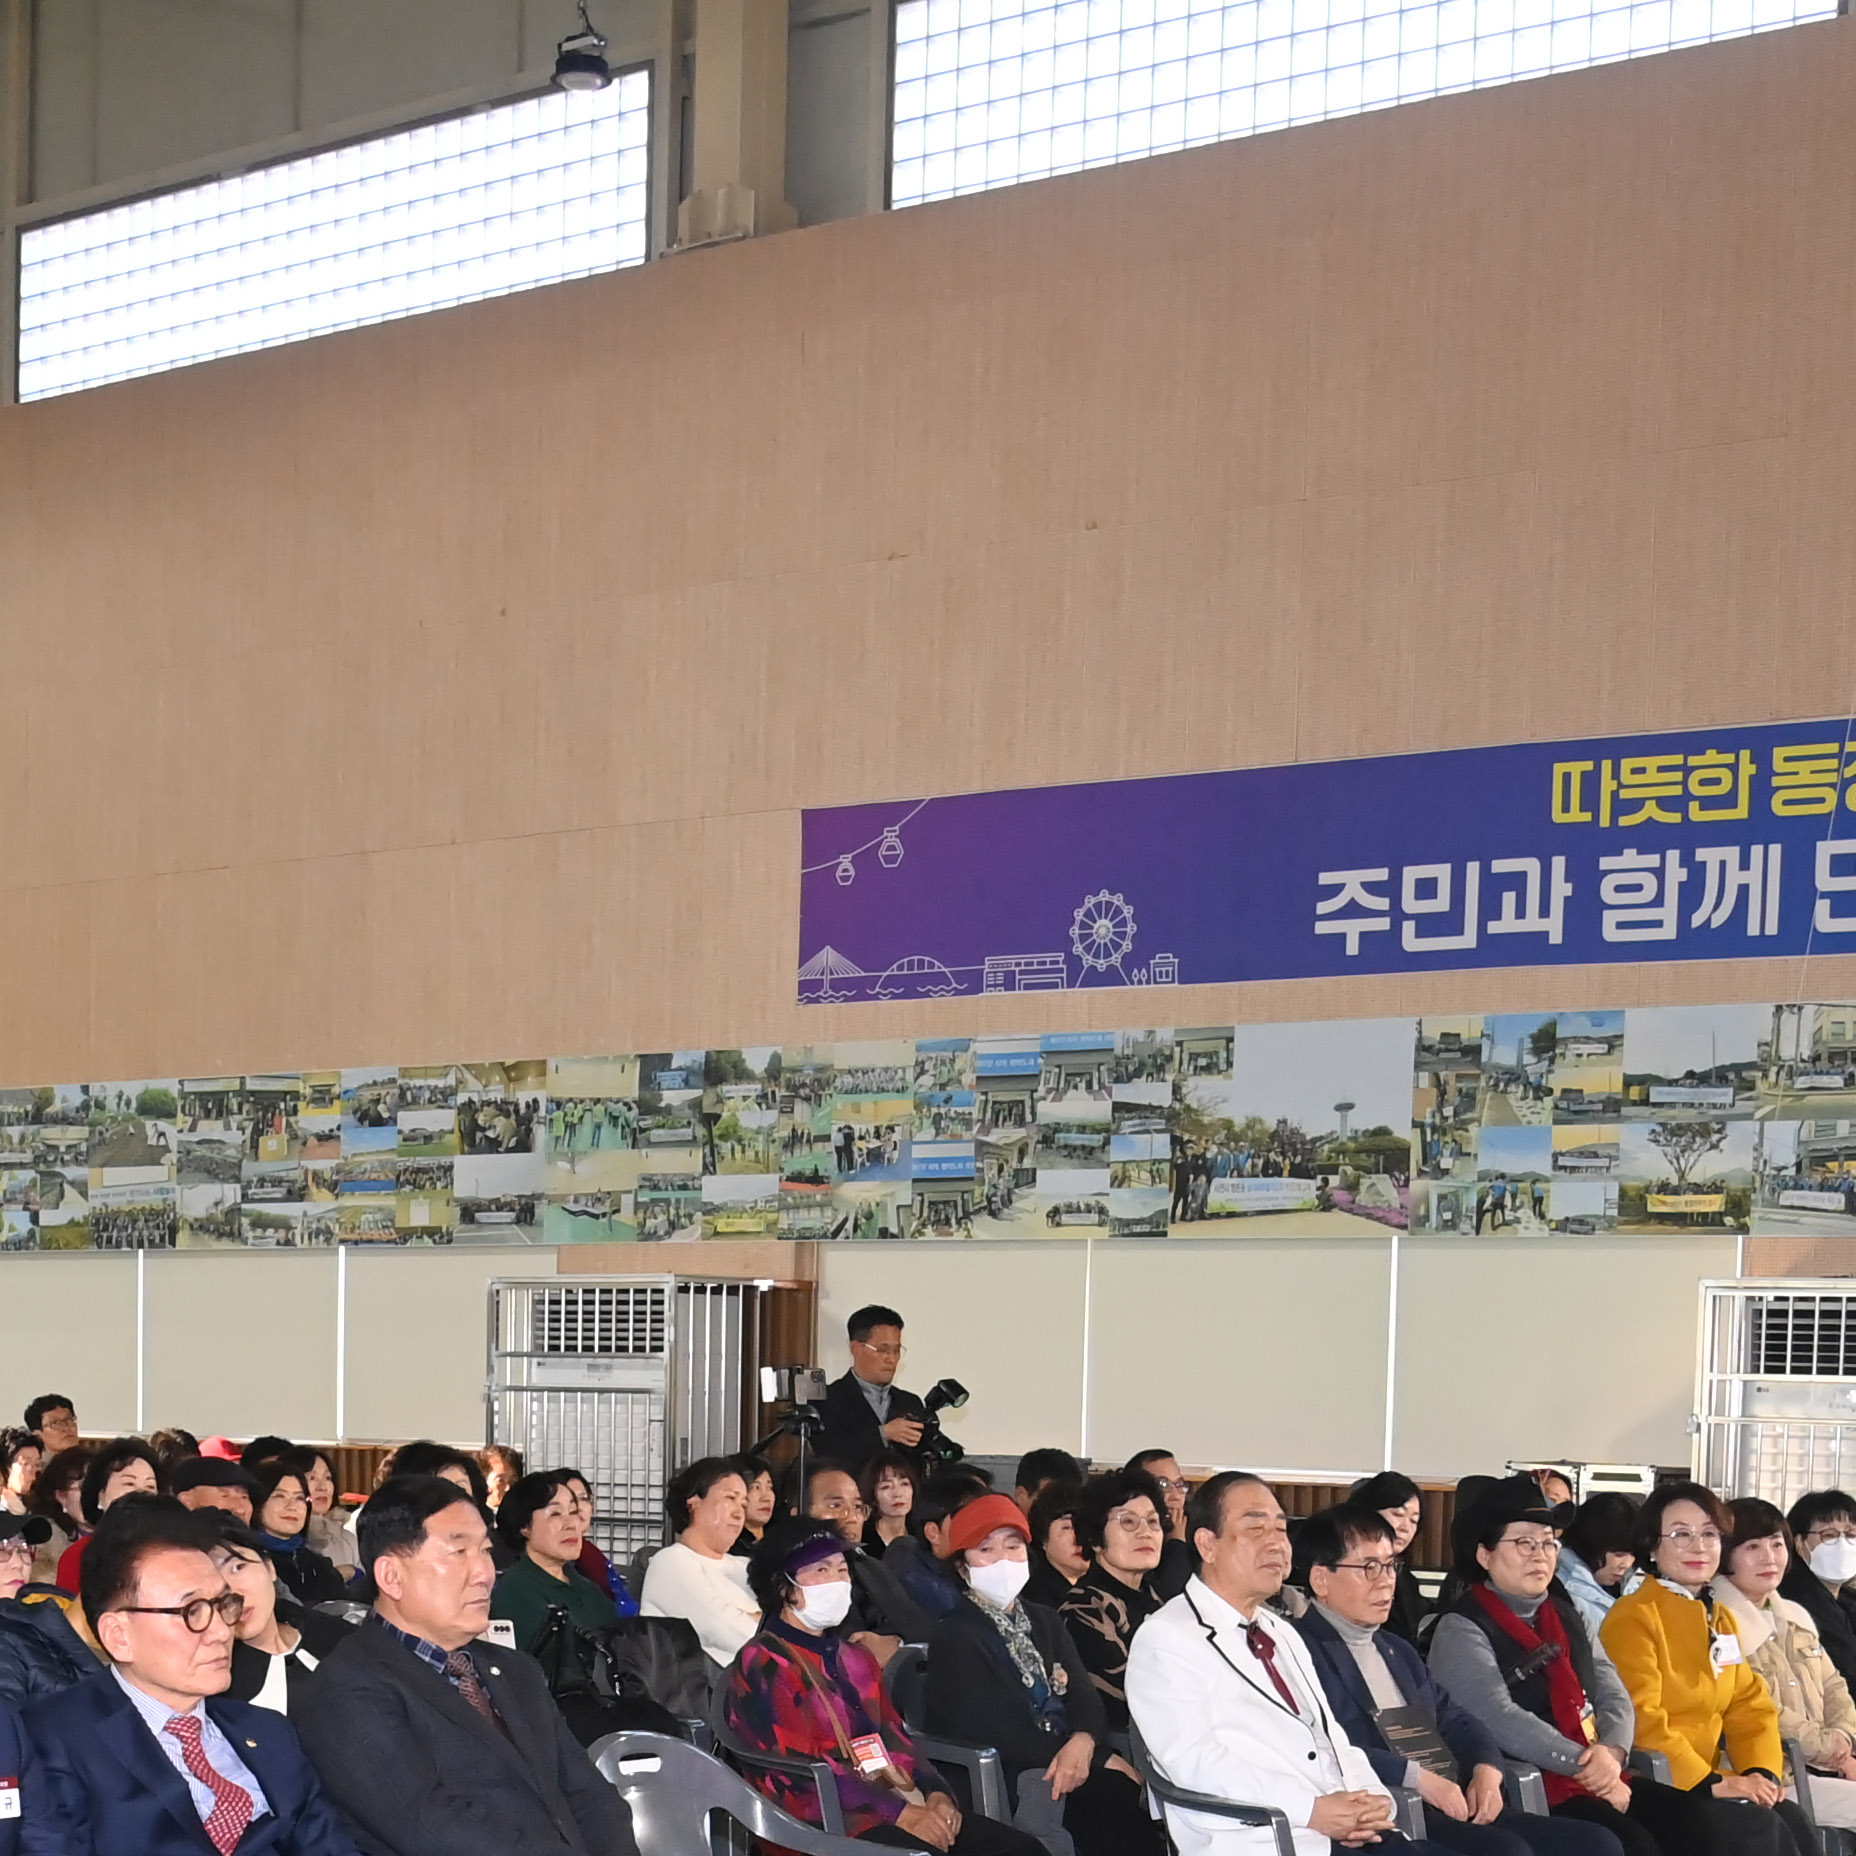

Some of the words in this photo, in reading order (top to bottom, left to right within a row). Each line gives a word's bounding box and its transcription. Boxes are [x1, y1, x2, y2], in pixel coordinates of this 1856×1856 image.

[1552, 749, 1757, 827] 따뜻한
[1314, 853, 1573, 956] 주민과
[1599, 843, 1785, 945] 함께
